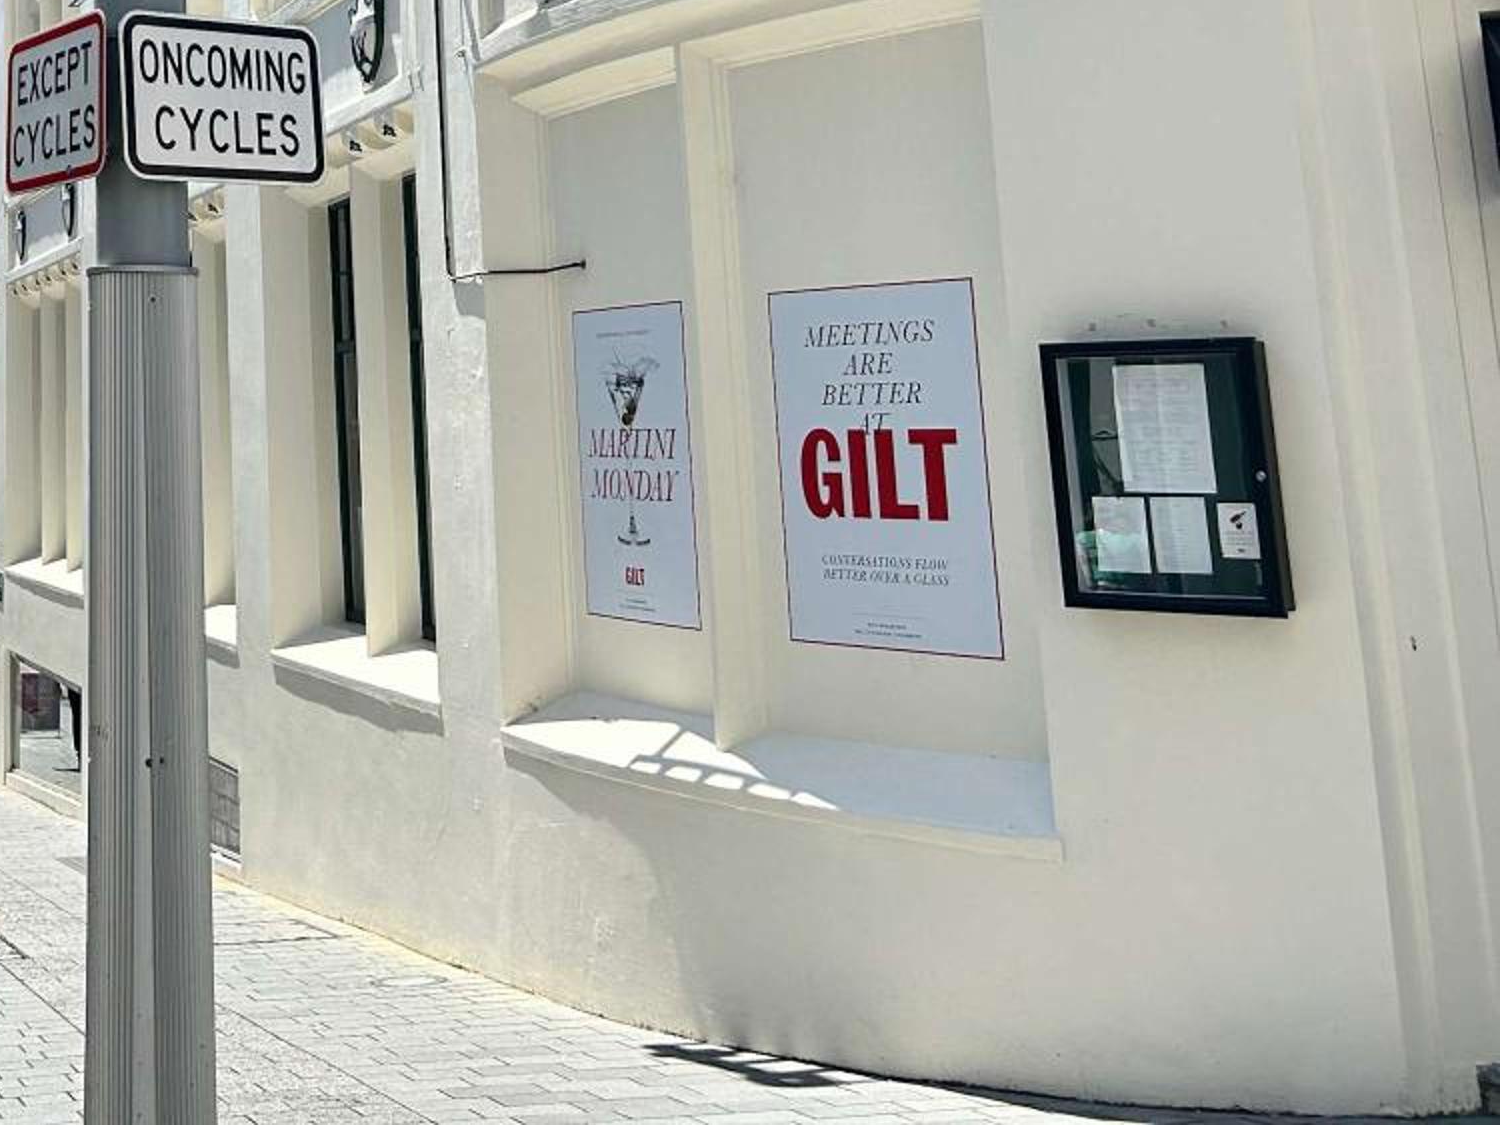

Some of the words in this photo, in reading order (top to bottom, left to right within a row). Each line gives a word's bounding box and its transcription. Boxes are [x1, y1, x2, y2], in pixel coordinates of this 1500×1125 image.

[17, 40, 93, 107] EXCEPT
[138, 38, 307, 95] ONCOMING
[12, 103, 96, 168] CYCLES
[155, 104, 301, 158] CYCLES
[803, 318, 935, 348] MEETINGS
[843, 352, 894, 376] ARE
[821, 382, 923, 406] BETTER
[861, 412, 893, 436] AT
[588, 427, 677, 461] MARTINI
[591, 467, 680, 502] MONDAY
[801, 428, 958, 522] GILT
[625, 566, 645, 586] GILT
